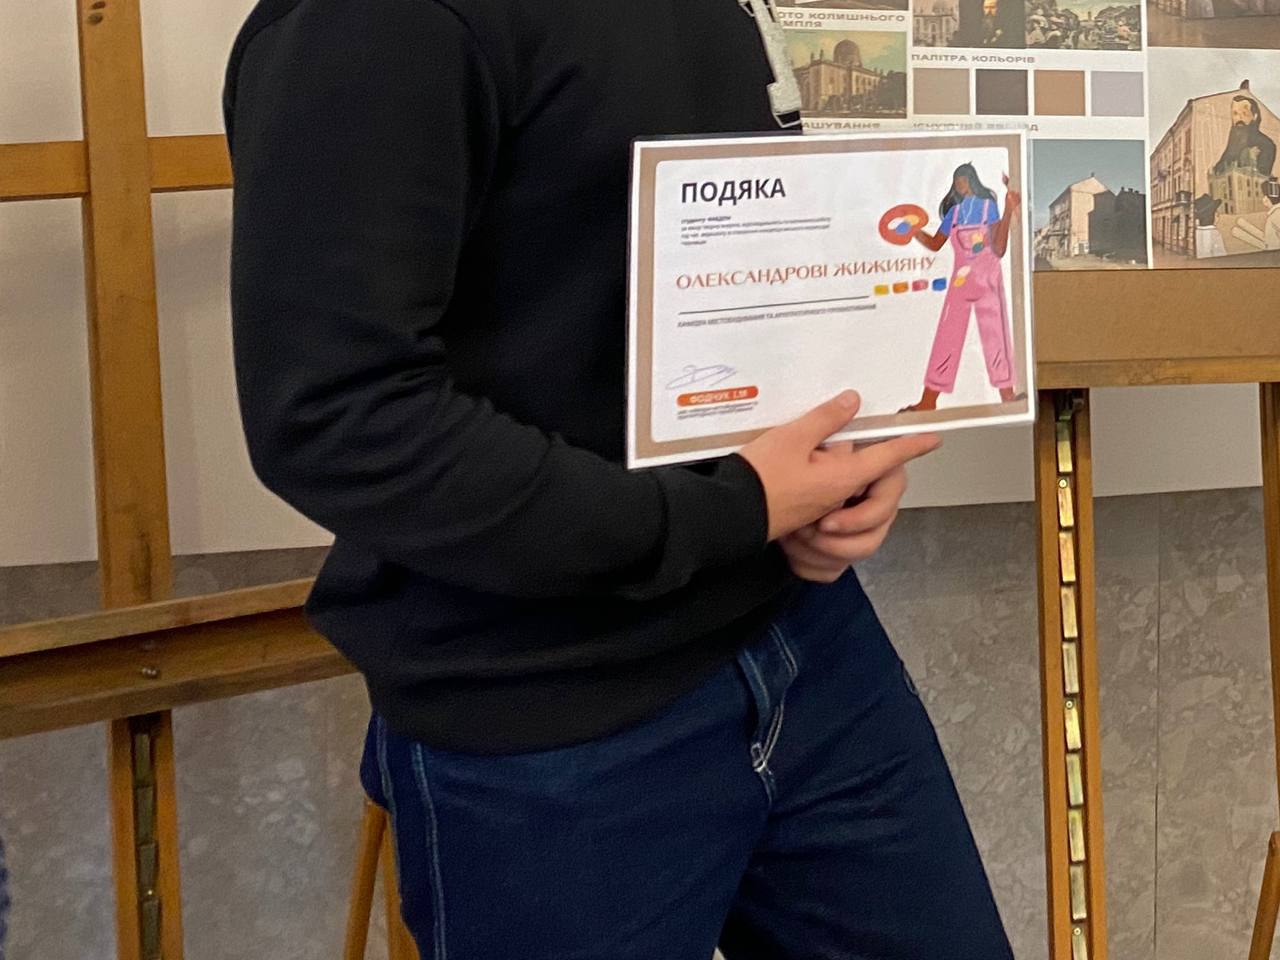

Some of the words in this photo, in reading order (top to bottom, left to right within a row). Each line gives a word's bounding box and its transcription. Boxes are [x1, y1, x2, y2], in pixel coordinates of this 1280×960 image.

[776, 11, 804, 19] ОТО
[808, 12, 905, 22] КОЛИШНЬОГО
[912, 54, 967, 63] ПАЛІТРА
[972, 55, 1036, 64] КОЛЬОРІВ
[681, 178, 787, 208] ПОДЯКА
[675, 265, 828, 290] ОЛЕКСАНДРОВІ
